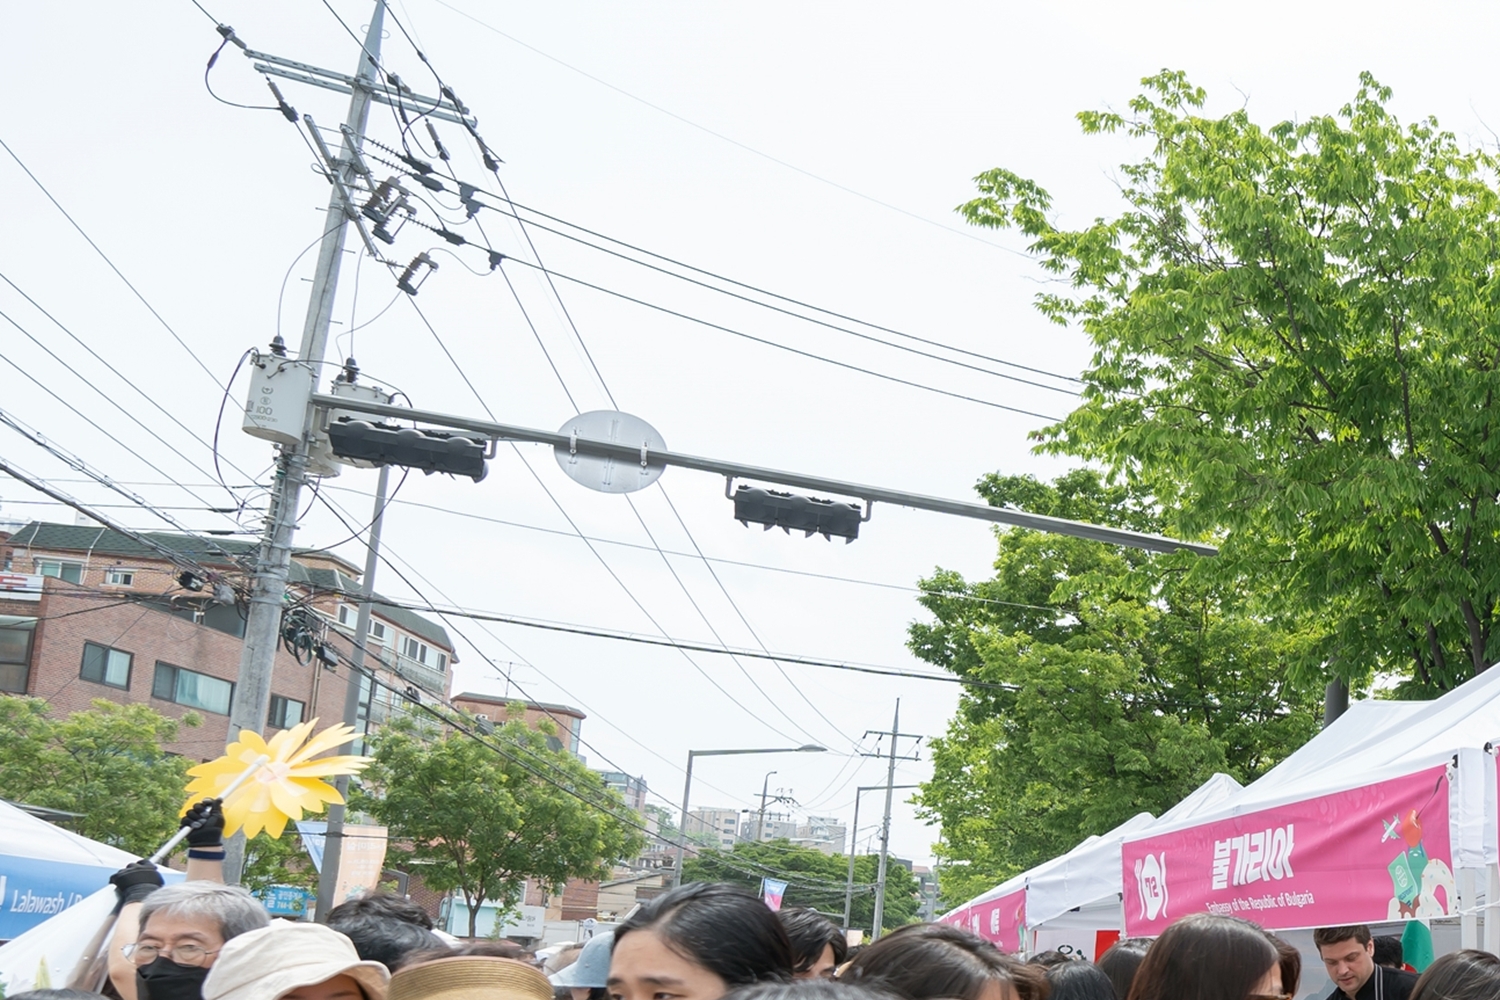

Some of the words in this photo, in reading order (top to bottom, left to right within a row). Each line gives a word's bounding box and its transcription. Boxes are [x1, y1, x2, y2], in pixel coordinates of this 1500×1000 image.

[1212, 824, 1294, 890] 불가리아
[1145, 876, 1159, 898] 72
[9, 889, 65, 914] Lalawash
[1205, 901, 1233, 914] Embassy
[1232, 898, 1240, 911] of
[1239, 897, 1251, 910] the
[1248, 894, 1278, 911] Republic
[1277, 892, 1286, 907] of
[1284, 890, 1314, 908] Bulgaria
